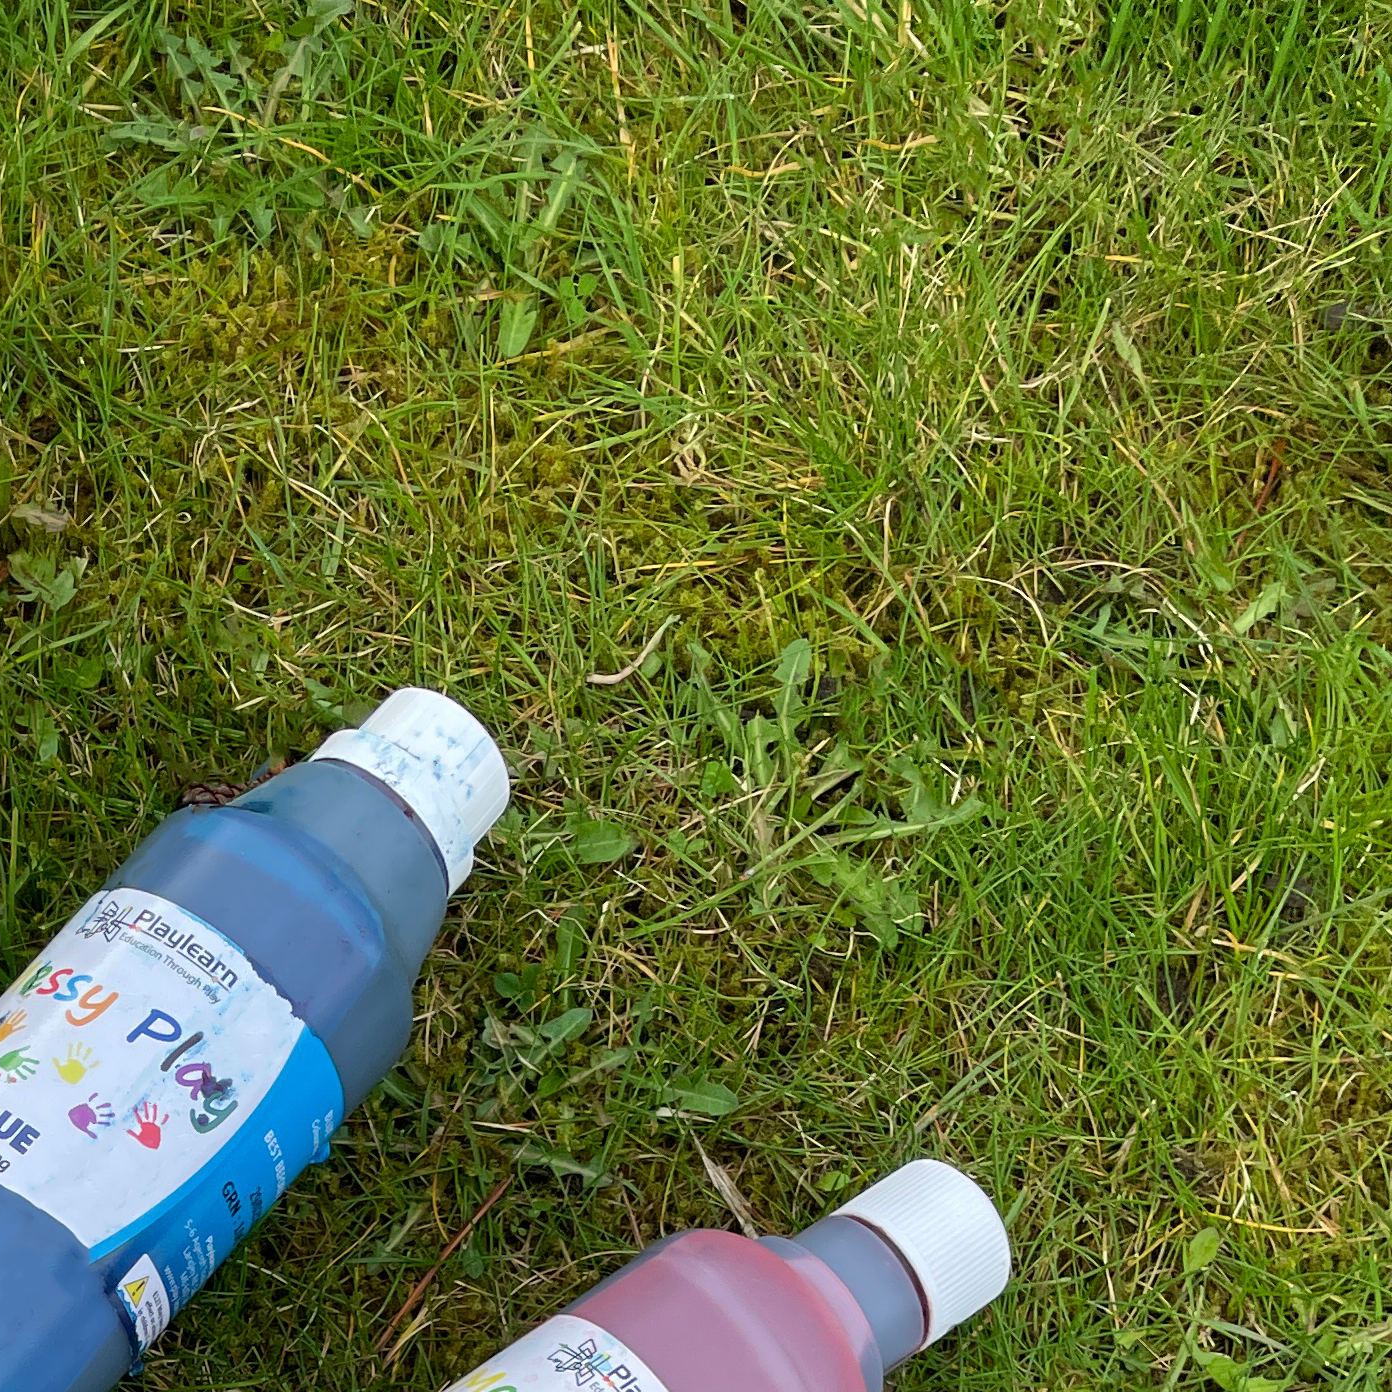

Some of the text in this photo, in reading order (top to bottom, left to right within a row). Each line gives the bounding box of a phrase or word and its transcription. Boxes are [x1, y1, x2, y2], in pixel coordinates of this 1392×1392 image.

[118, 931, 163, 961] Education
[162, 953, 202, 989] Through
[132, 908, 239, 989] Playlearn
[126, 1008, 238, 1134] Play
[263, 1128, 283, 1162] BEST
[221, 1180, 242, 1218] GRN
